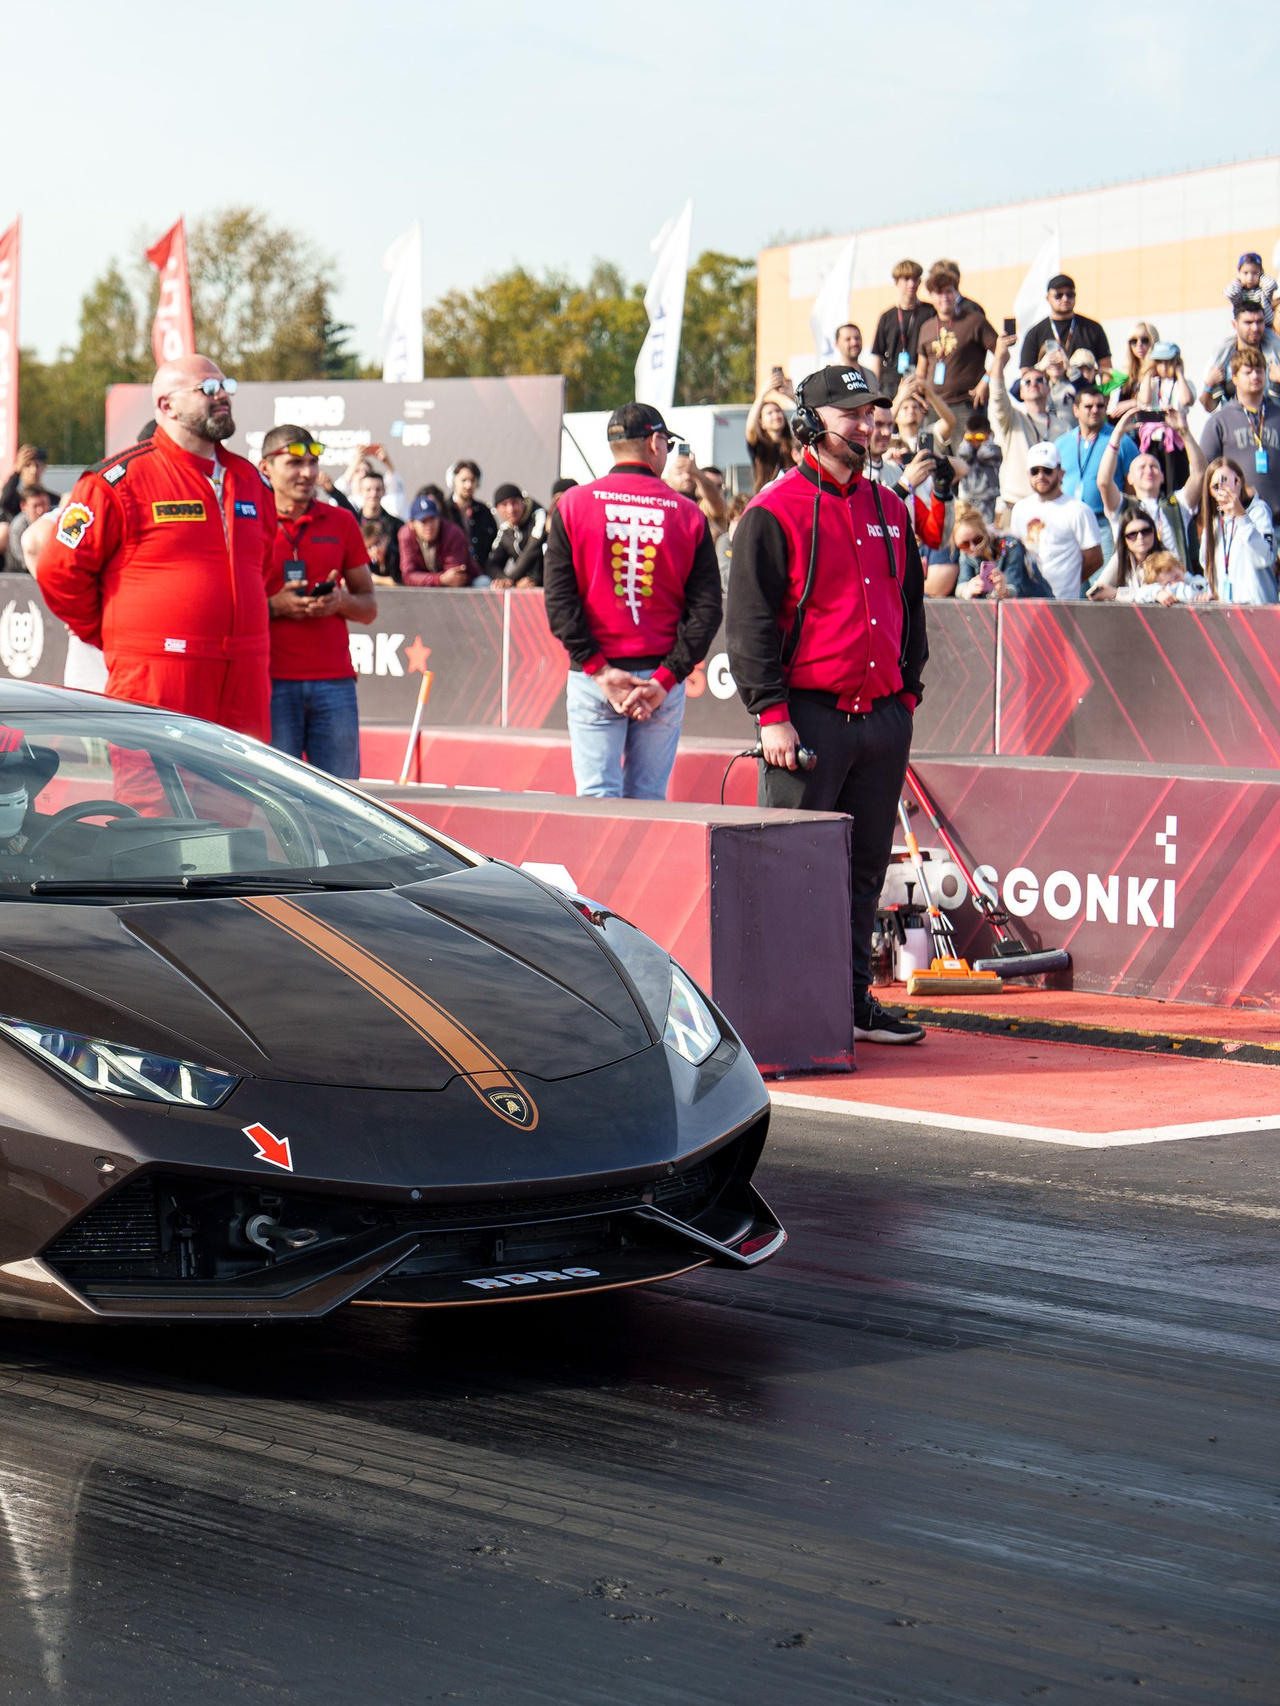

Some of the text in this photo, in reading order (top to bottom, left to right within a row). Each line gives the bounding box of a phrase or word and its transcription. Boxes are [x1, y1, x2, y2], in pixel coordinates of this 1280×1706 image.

[841, 371, 865, 384] RDR
[348, 632, 406, 677] RK
[937, 861, 1177, 929] OSGONKI
[461, 1266, 601, 1290] RDRC
